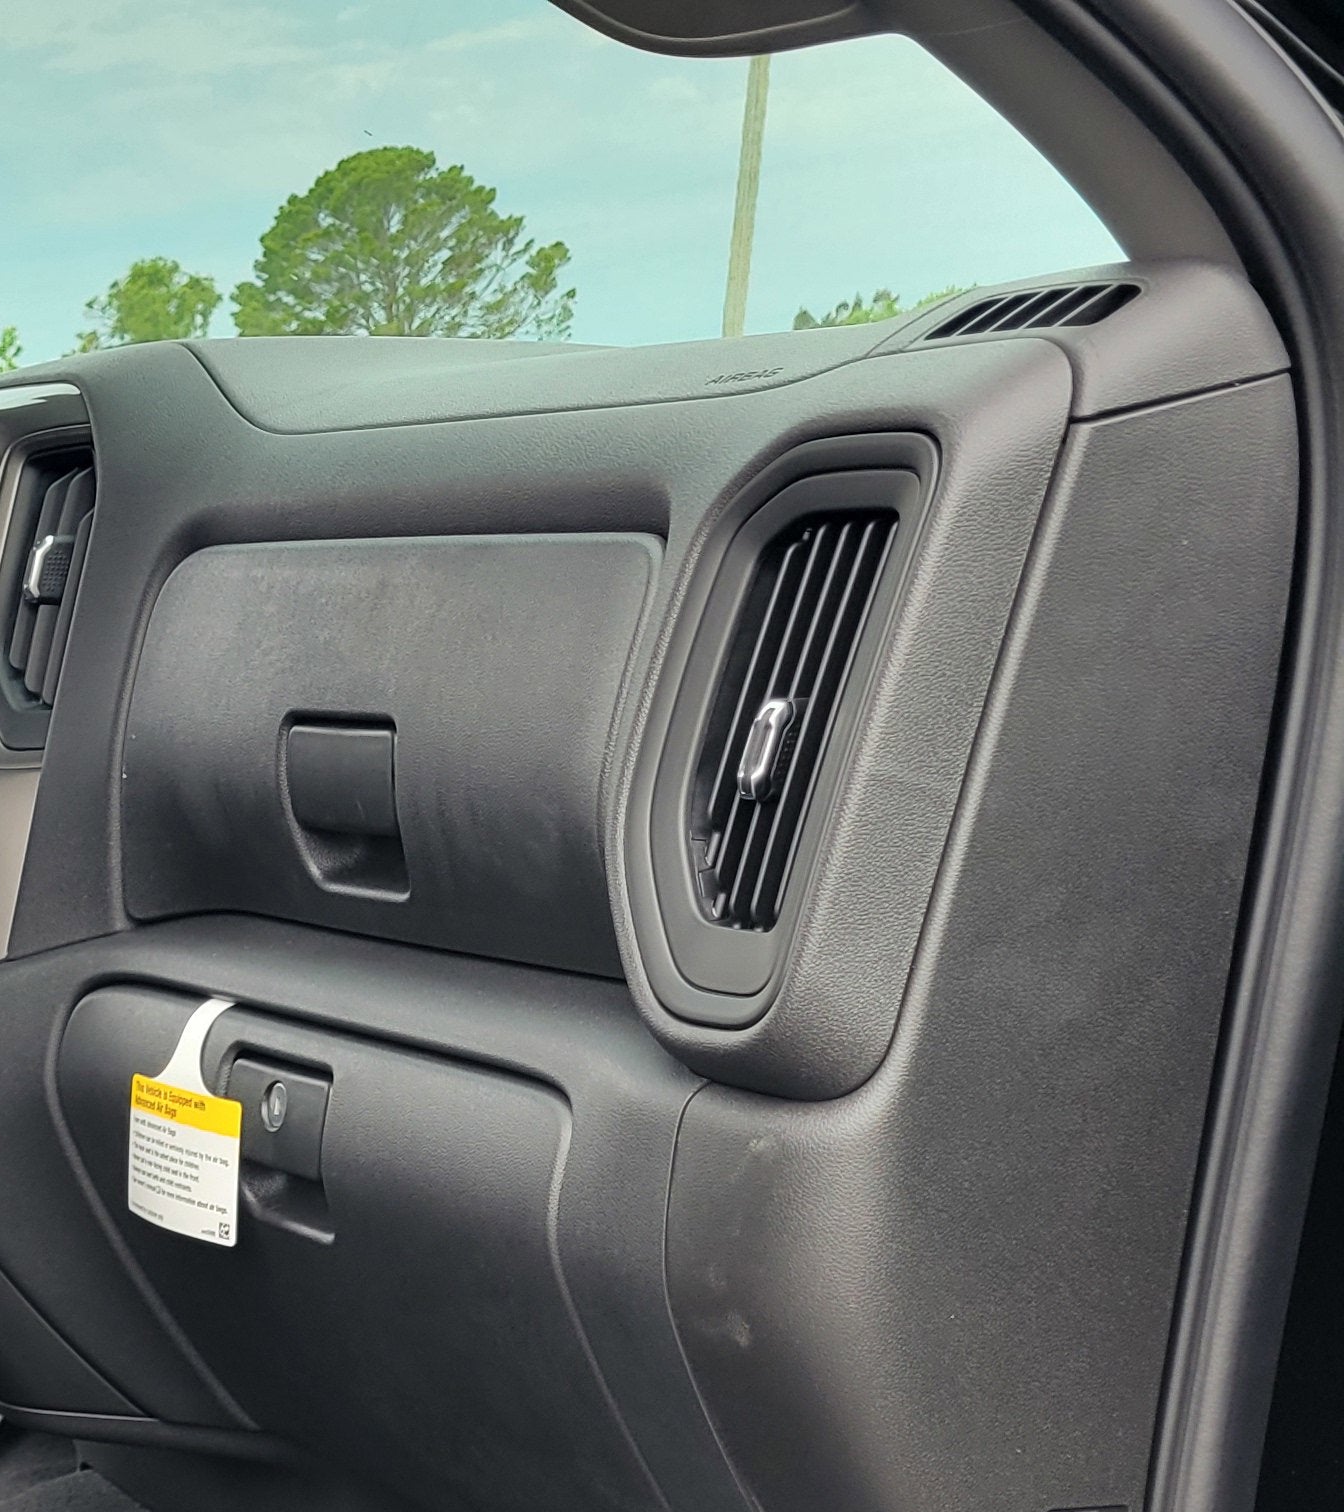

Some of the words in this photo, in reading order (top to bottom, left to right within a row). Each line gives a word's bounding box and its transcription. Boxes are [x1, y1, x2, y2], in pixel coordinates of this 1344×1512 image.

[705, 366, 784, 386] AIRBAG
[169, 1090, 192, 1108] Equipped
[194, 1099, 205, 1110] with
[165, 1104, 177, 1119] Bags
